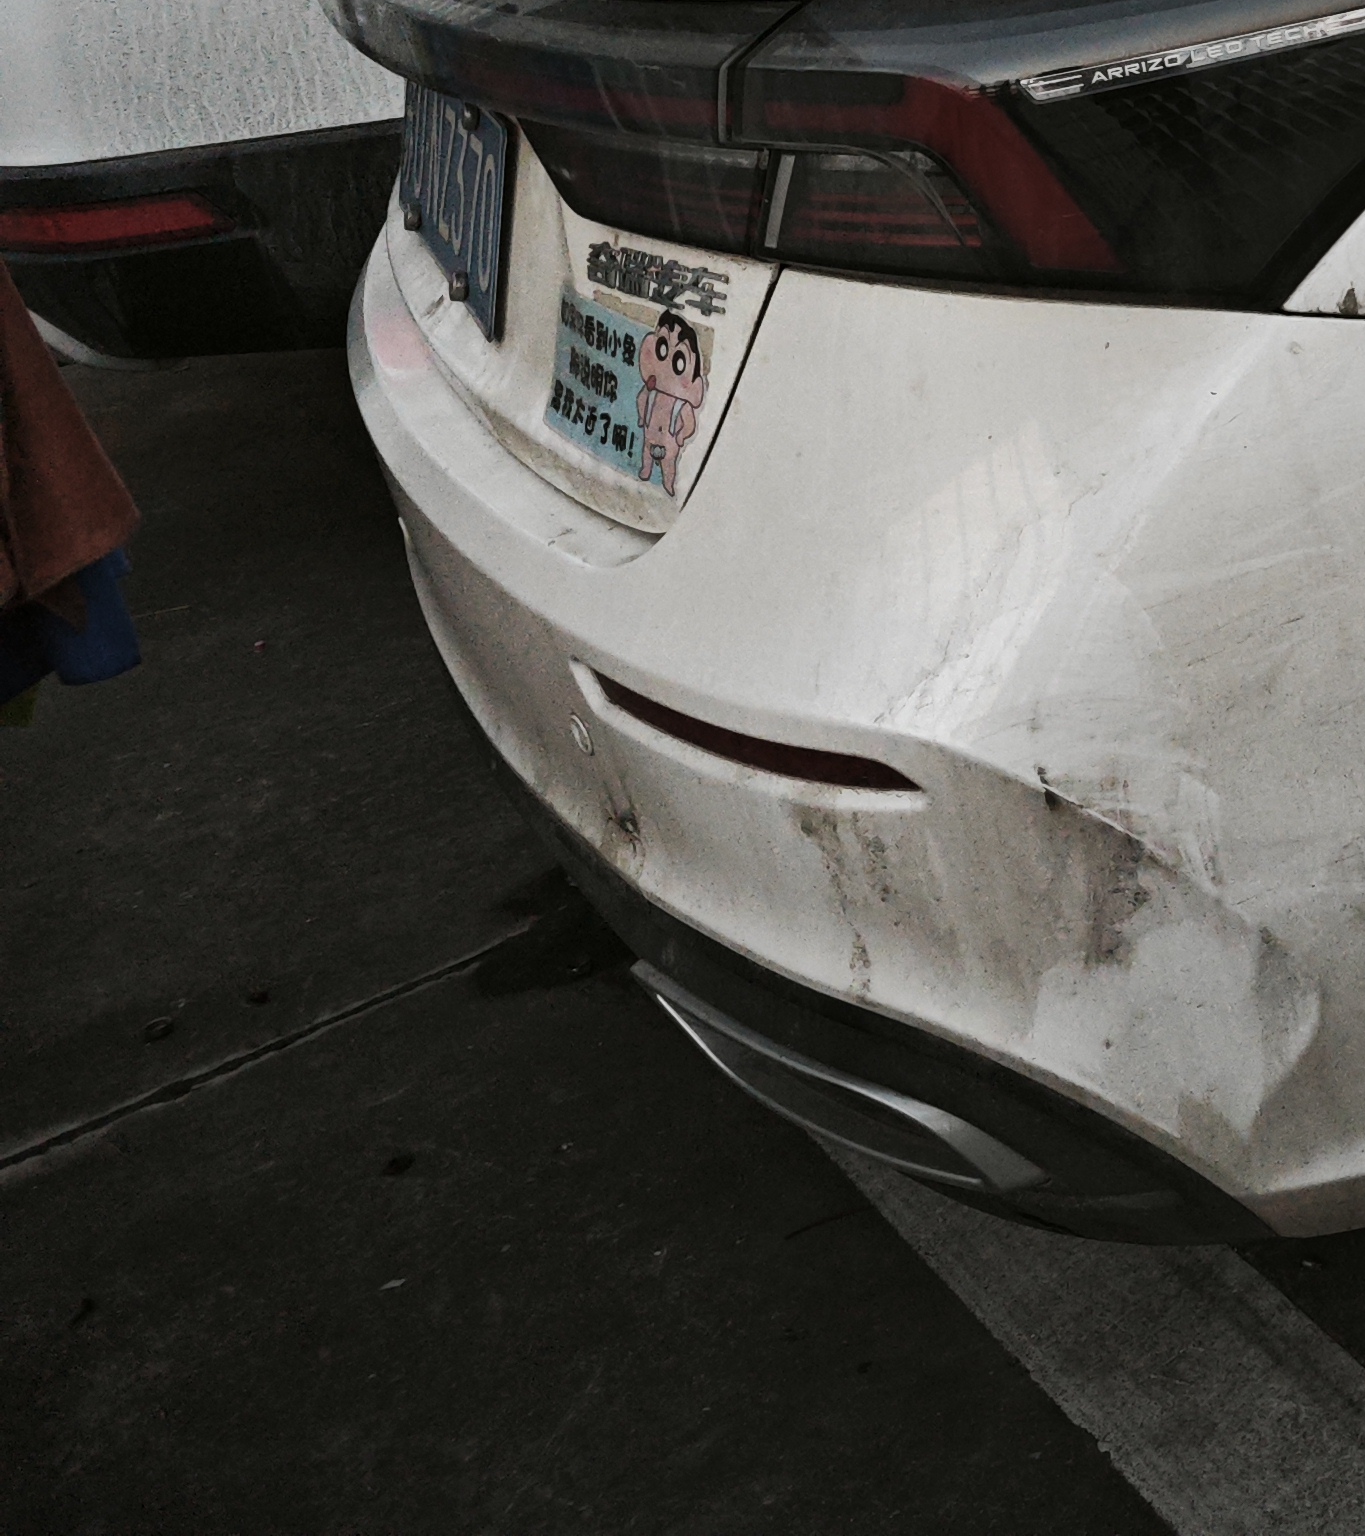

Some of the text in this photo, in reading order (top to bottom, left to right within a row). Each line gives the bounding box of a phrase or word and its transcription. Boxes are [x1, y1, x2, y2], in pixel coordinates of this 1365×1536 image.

[1091, 54, 1182, 85] ARRIZO
[1190, 40, 1244, 64] LED
[587, 241, 730, 317] 奇瑞汽车
